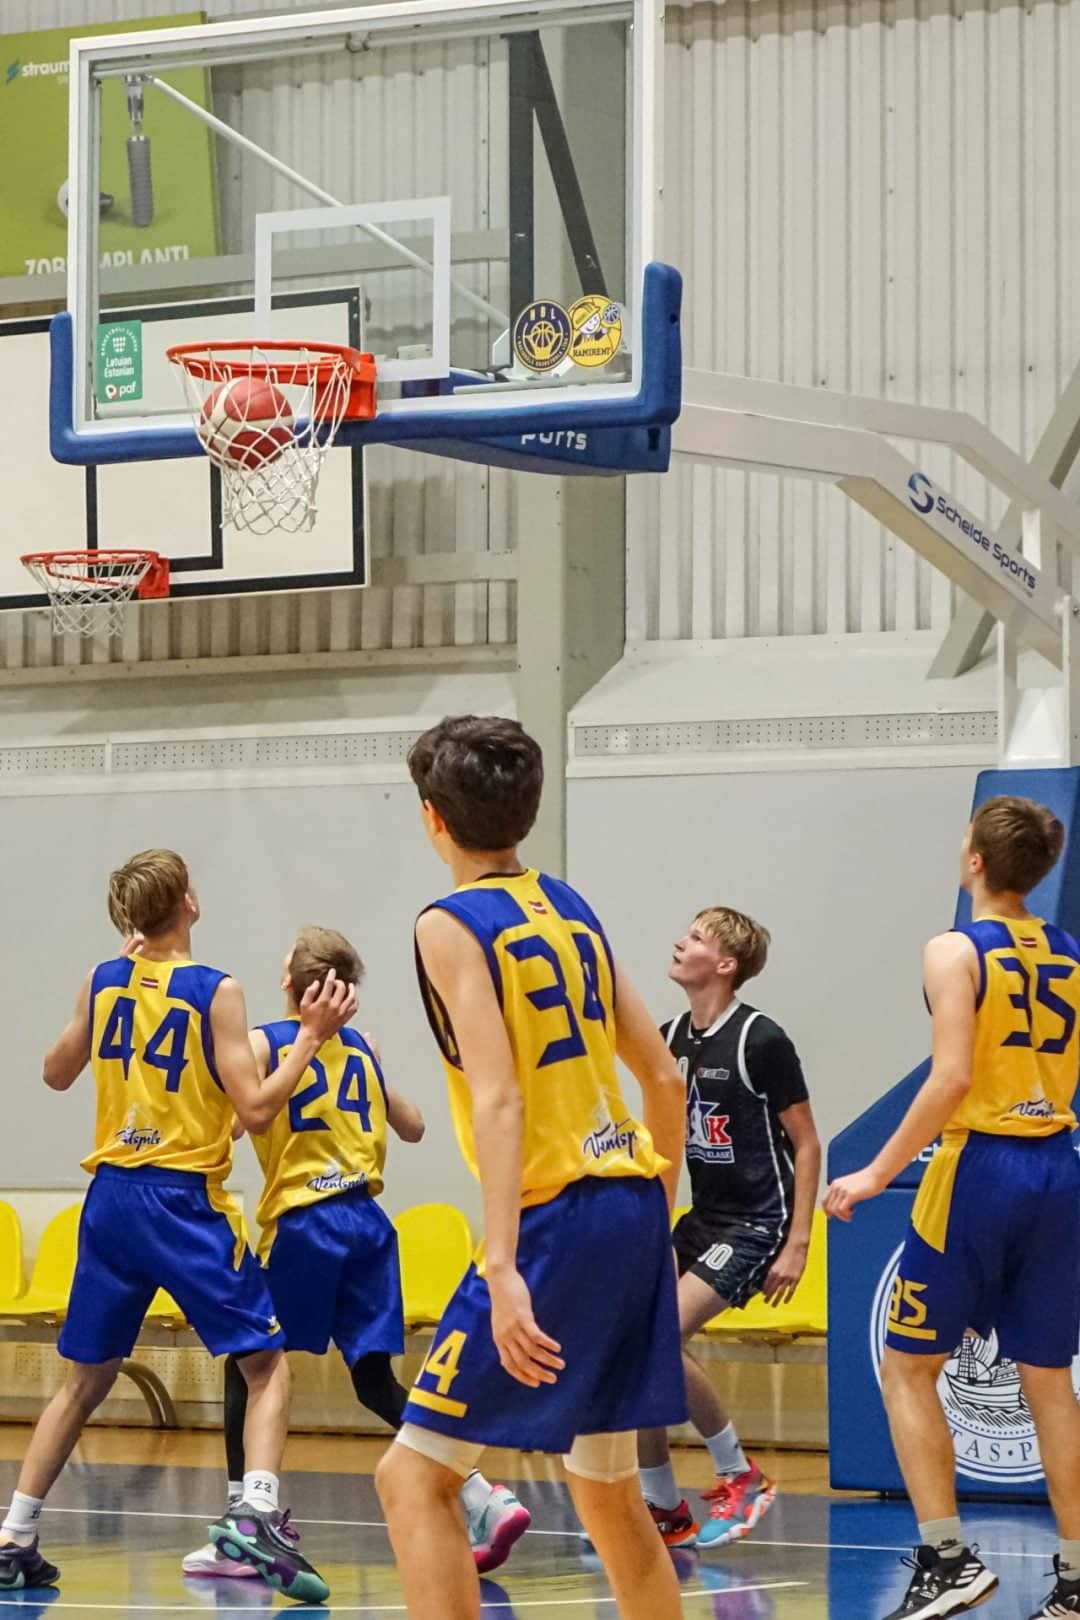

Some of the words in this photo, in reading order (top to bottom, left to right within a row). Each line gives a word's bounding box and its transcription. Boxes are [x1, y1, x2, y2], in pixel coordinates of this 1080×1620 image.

[104, 367, 134, 378] Estonian
[119, 381, 136, 397] paf
[935, 496, 991, 551] Schelde
[992, 543, 1036, 589] Sports
[996, 956, 1076, 1055] 35
[98, 996, 190, 1093] 44
[286, 1053, 373, 1134] 24
[697, 1243, 734, 1270] 10
[425, 1329, 468, 1395] 4
